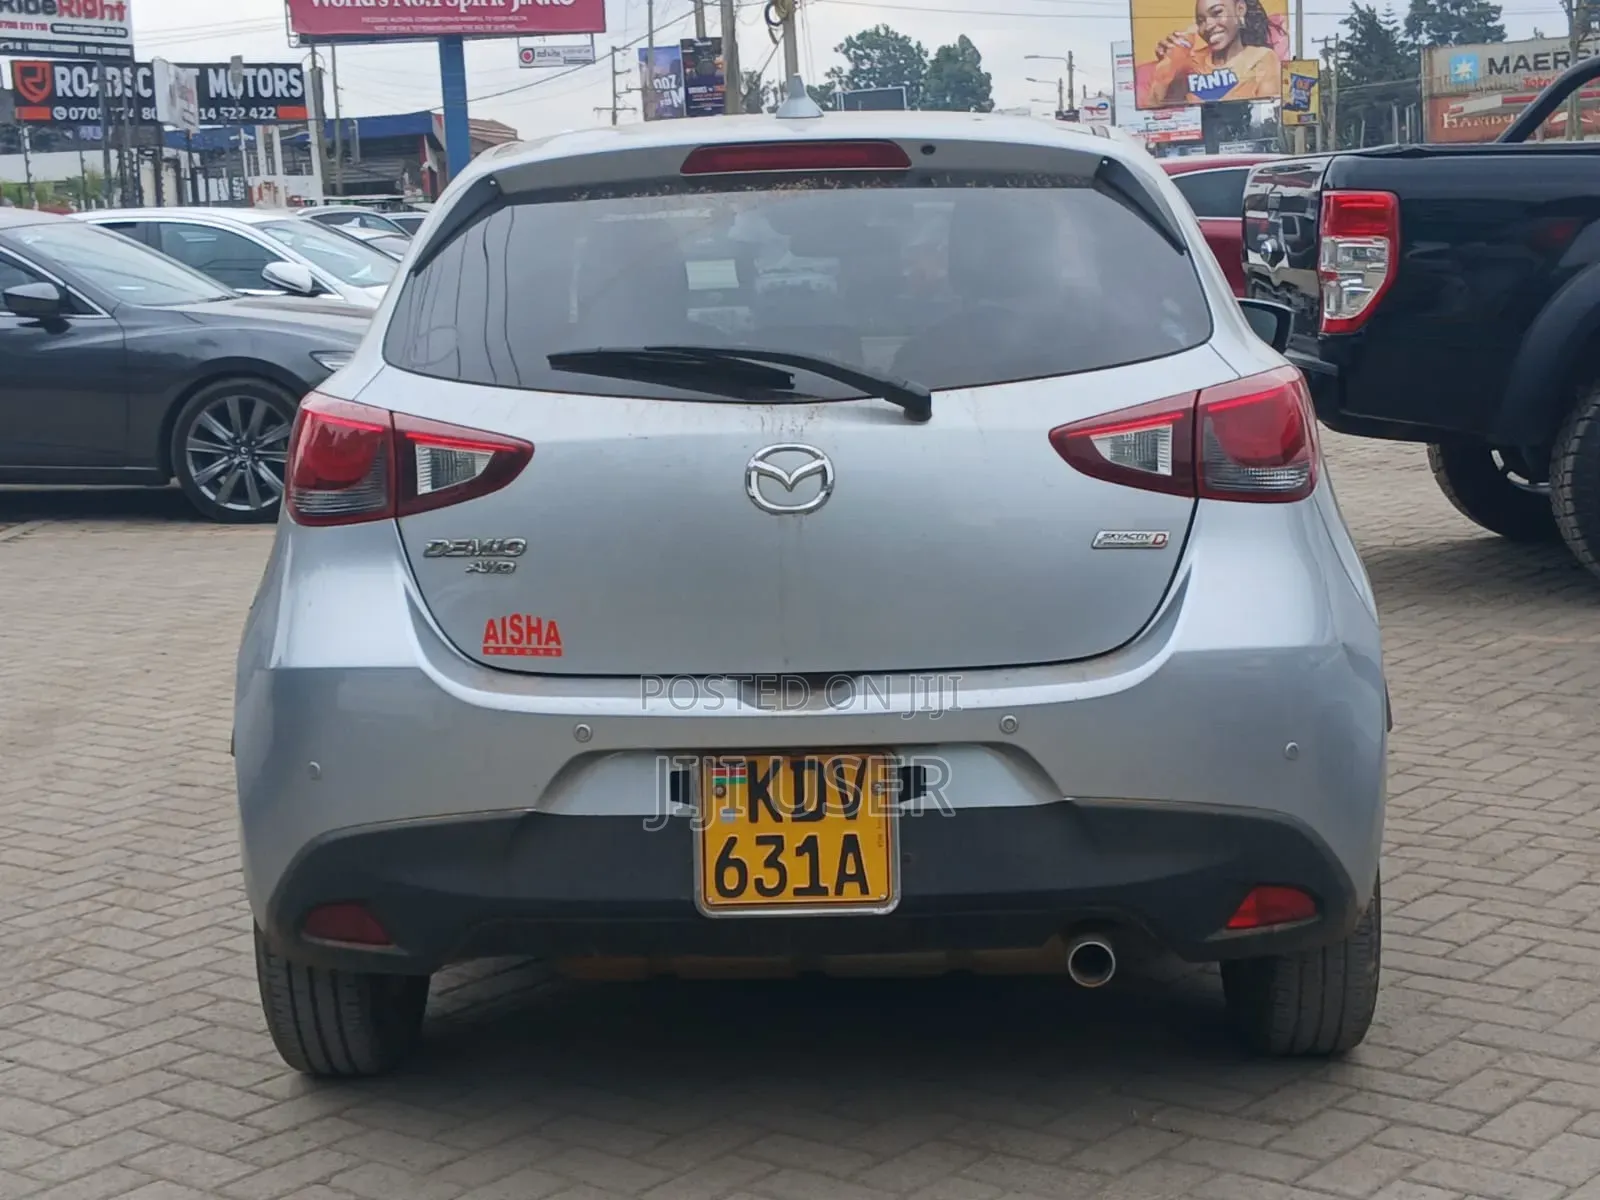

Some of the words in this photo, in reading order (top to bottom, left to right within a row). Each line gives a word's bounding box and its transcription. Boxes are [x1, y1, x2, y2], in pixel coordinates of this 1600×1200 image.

[1487, 47, 1600, 75] MAERS
[207, 67, 304, 99] MOTORS
[1187, 68, 1238, 92] FANTA
[249, 106, 277, 119] 422
[423, 536, 527, 557] DEMIO
[1152, 533, 1167, 545] D
[465, 560, 517, 574] AWD
[482, 613, 562, 646] AISHA
[748, 758, 868, 824] KDV
[714, 833, 870, 898] 631A
